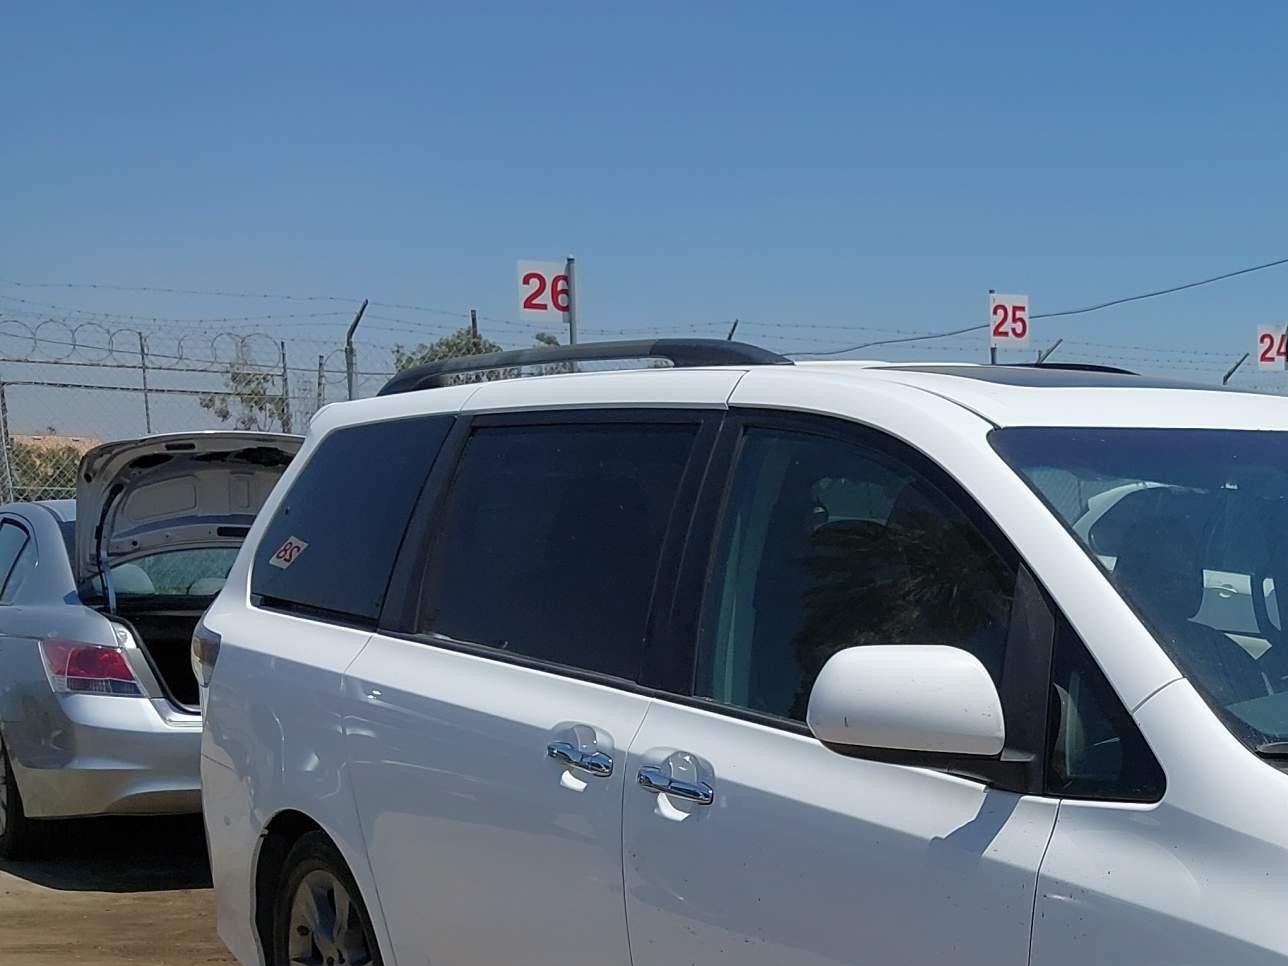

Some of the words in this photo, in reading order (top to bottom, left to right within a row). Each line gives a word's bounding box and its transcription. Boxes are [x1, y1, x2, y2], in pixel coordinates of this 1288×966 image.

[522, 272, 569, 312] 26
[993, 304, 1027, 338] 25
[1260, 333, 1288, 363] 24
